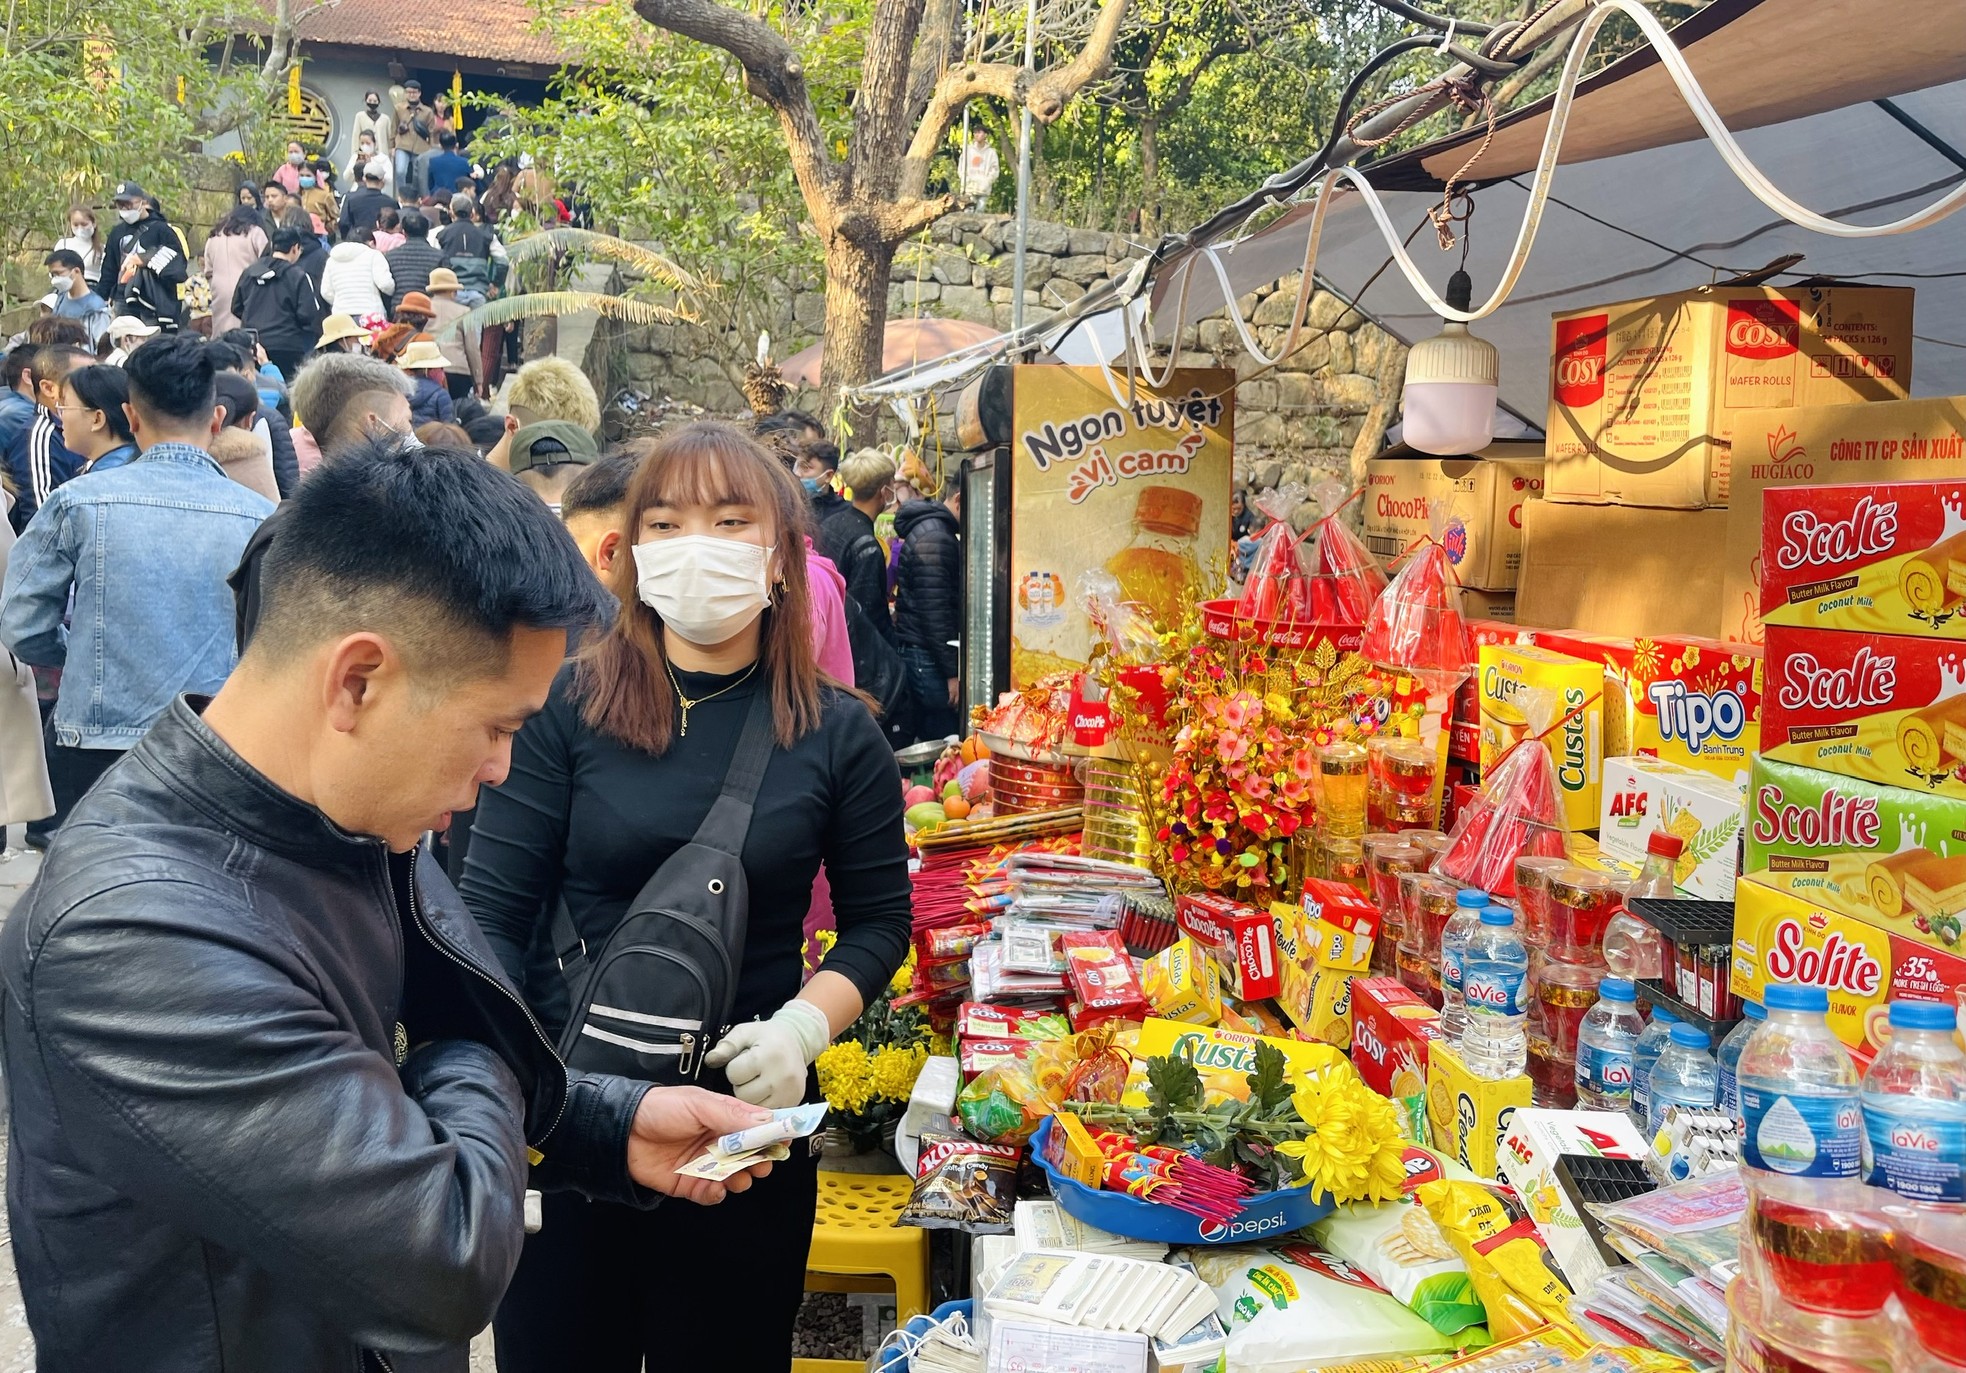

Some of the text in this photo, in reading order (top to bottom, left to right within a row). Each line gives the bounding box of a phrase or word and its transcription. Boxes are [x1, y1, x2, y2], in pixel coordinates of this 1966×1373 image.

[1728, 319, 1796, 348] COSY
[1834, 323, 1877, 332] CONTENTS:
[1833, 335, 1859, 343] PACKS
[1867, 335, 1880, 344] 126
[1557, 354, 1605, 387] COSY
[1730, 376, 1791, 386] WAFER ROLLS
[1025, 391, 1222, 467] Ngon tuyệt
[1555, 442, 1599, 454] WAFER ROLLS
[1830, 429, 1965, 461] CÔNG TY CP SẢN XUẤT
[1079, 449, 1185, 483] vị cam
[1751, 464, 1814, 480] HUGIACO
[1375, 474, 1394, 485] ORION
[1791, 578, 1853, 600] Butter Milk Flavor
[1818, 595, 1873, 614] Coconut Milk
[1074, 714, 1105, 728] ChocoPie
[1649, 680, 1745, 755] Tipo
[1559, 688, 1586, 791] Custas
[1792, 726, 1853, 741] Butter Milk Flavor
[1818, 743, 1872, 758] Coconut Milk
[1609, 791, 1648, 817] AFC
[1753, 784, 1882, 848] Scolité
[1771, 859, 1825, 870] Butter Milk Flavor
[1792, 878, 1841, 894] Coconut Milk
[1303, 892, 1322, 919] Tipo
[1184, 909, 1222, 941] ChocoPie
[1329, 934, 1344, 962] Tipo
[1767, 918, 1882, 997] Solite
[1173, 947, 1183, 986] Custas
[1092, 998, 1122, 1008] COSY
[1466, 983, 1507, 1003] laVie
[968, 1008, 1006, 1020] COSY
[1159, 1000, 1197, 1020] ustas
[1832, 1002, 1857, 1016] FLAVOR
[973, 1043, 1013, 1051] COSY
[1224, 1033, 1258, 1044] ORION
[1356, 1020, 1387, 1066] COSY
[1507, 1135, 1534, 1164] AFC
[1892, 1132, 1938, 1150] laVie
[920, 1141, 1015, 1172] KOPIKO
[967, 1162, 989, 1170] Candy
[1229, 1211, 1285, 1238] pepsi
